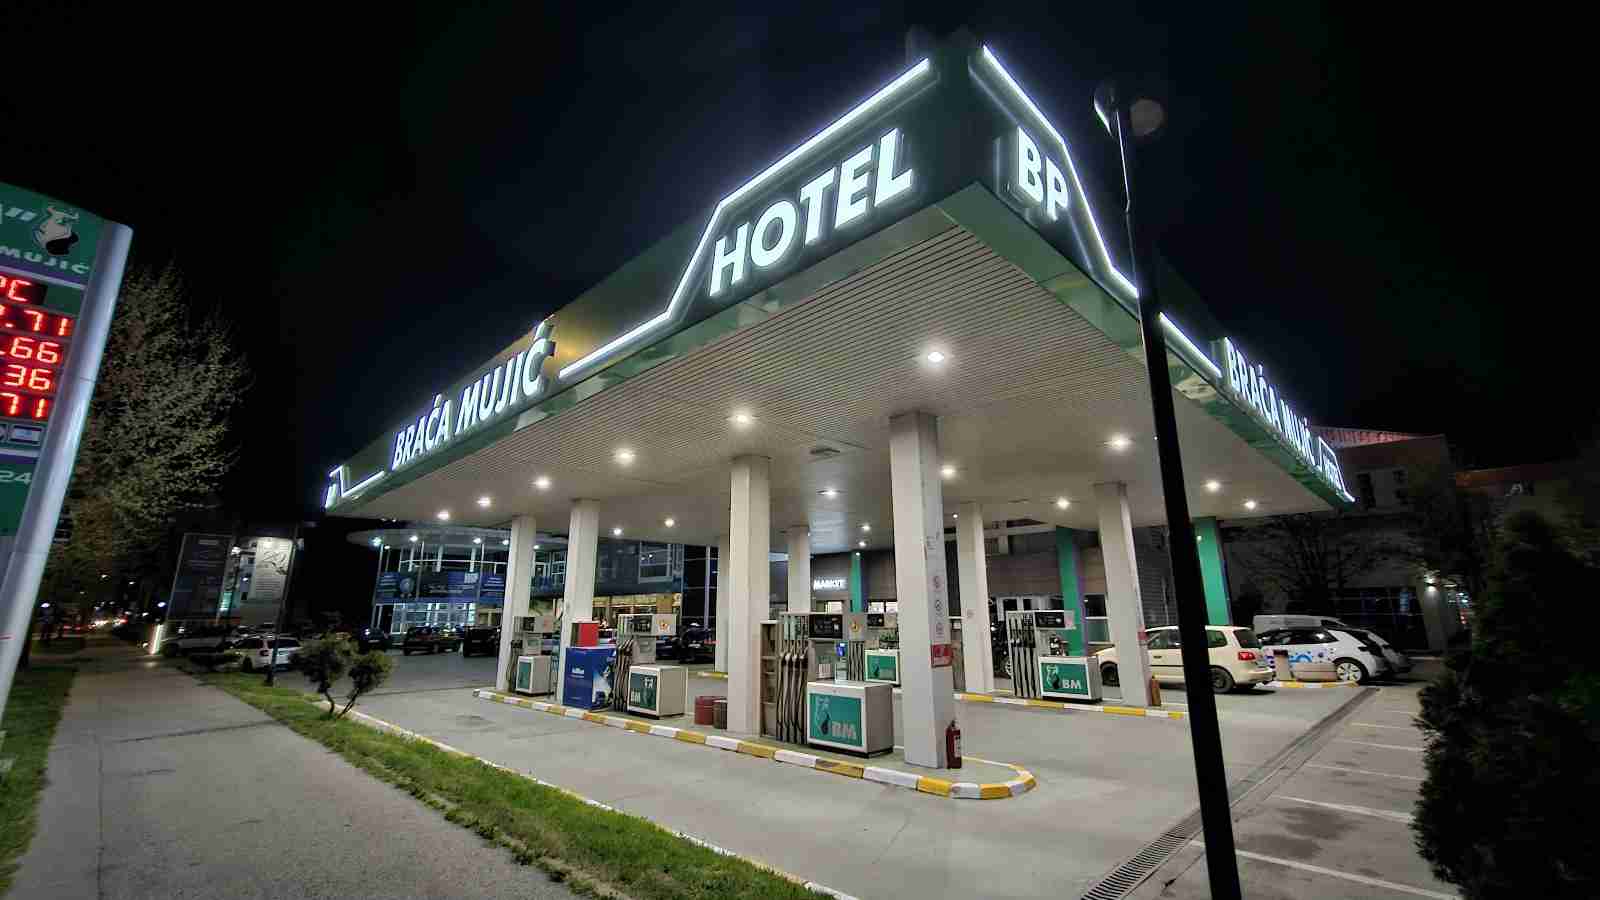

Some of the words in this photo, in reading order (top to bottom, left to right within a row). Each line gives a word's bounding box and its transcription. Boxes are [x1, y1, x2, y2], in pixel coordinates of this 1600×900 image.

[709, 127, 914, 297] HOTEL
[1017, 127, 1069, 222] BP
[391, 393, 453, 472] BRAĆA
[455, 315, 557, 436] MUJIĆ
[1224, 336, 1284, 434] BRAĆA
[1061, 679, 1083, 690] BM
